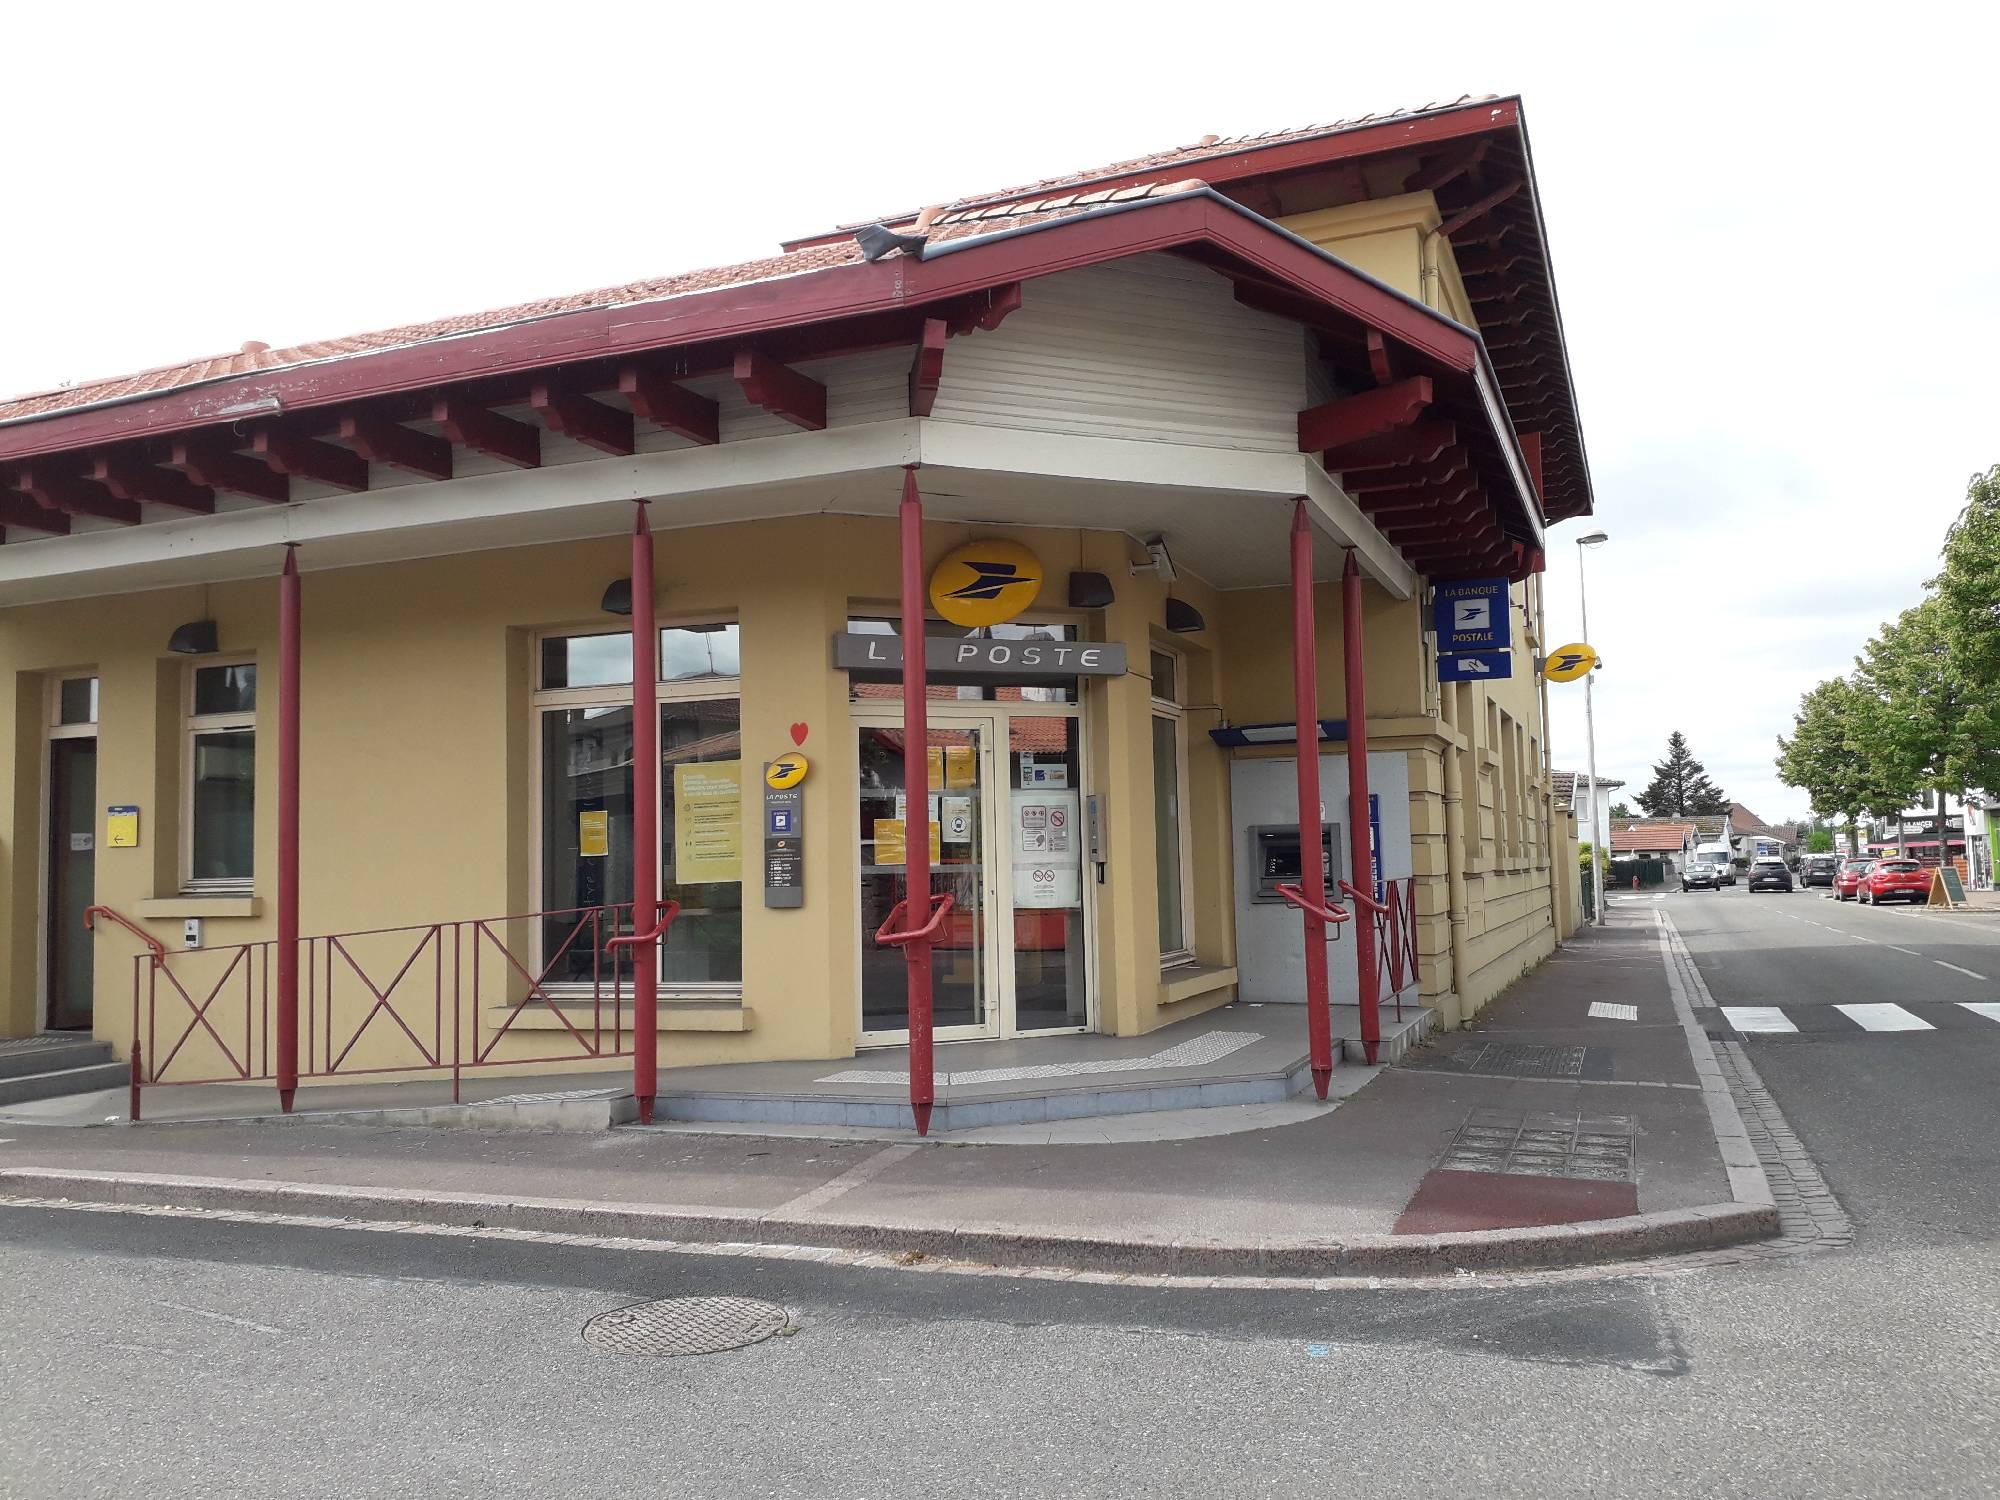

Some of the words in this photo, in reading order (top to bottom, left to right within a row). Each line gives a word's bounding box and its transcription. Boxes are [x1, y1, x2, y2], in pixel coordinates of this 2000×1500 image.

[1445, 589, 1456, 597] LA
[1458, 586, 1498, 596] BANQUE
[1453, 632, 1494, 642] POSTALE
[957, 645, 1101, 667] POSTE
